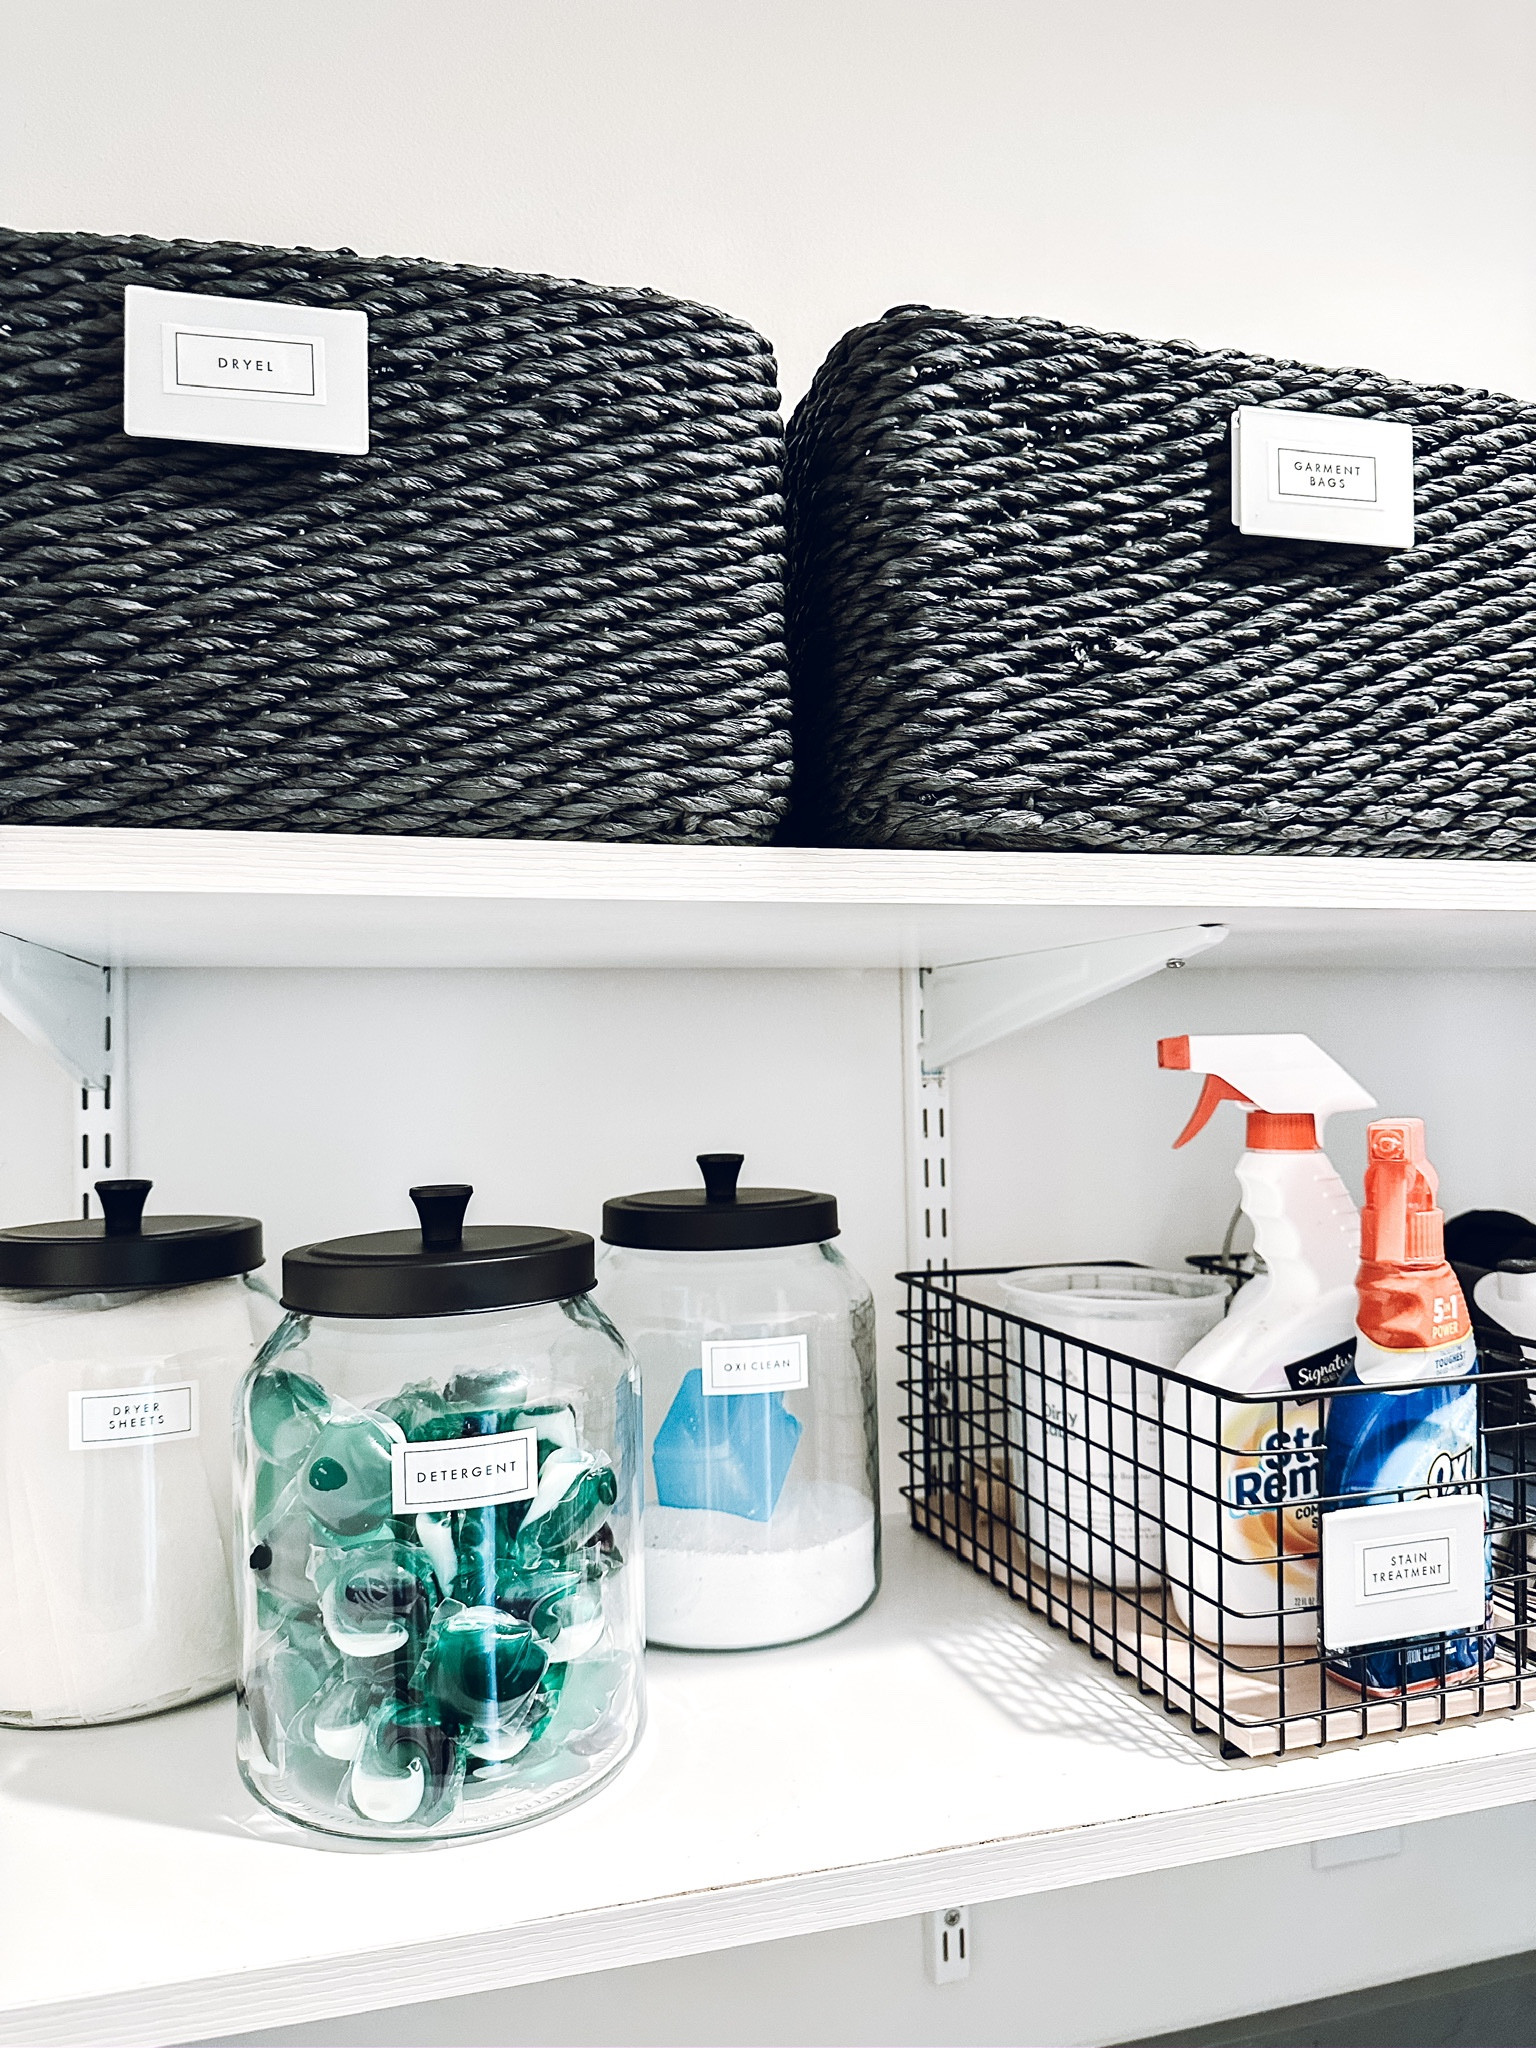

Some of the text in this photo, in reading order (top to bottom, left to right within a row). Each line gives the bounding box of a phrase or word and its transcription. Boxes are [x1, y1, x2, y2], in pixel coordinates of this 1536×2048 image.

[218, 357, 273, 372] DRYEL
[1294, 461, 1361, 476] GARMENT
[1309, 476, 1345, 488] BAGS
[1432, 1321, 1459, 1339] POWER
[724, 1360, 790, 1372] OXI CLEAN
[1435, 1351, 1466, 1368] TOUGHEST
[113, 1402, 160, 1416] DRYER
[1044, 1402, 1078, 1428] Diry
[109, 1415, 165, 1430] SHEETS
[417, 1461, 516, 1483] DETERGENT
[1391, 1552, 1427, 1567] STAIN
[1373, 1564, 1442, 1583] TREATMENT
